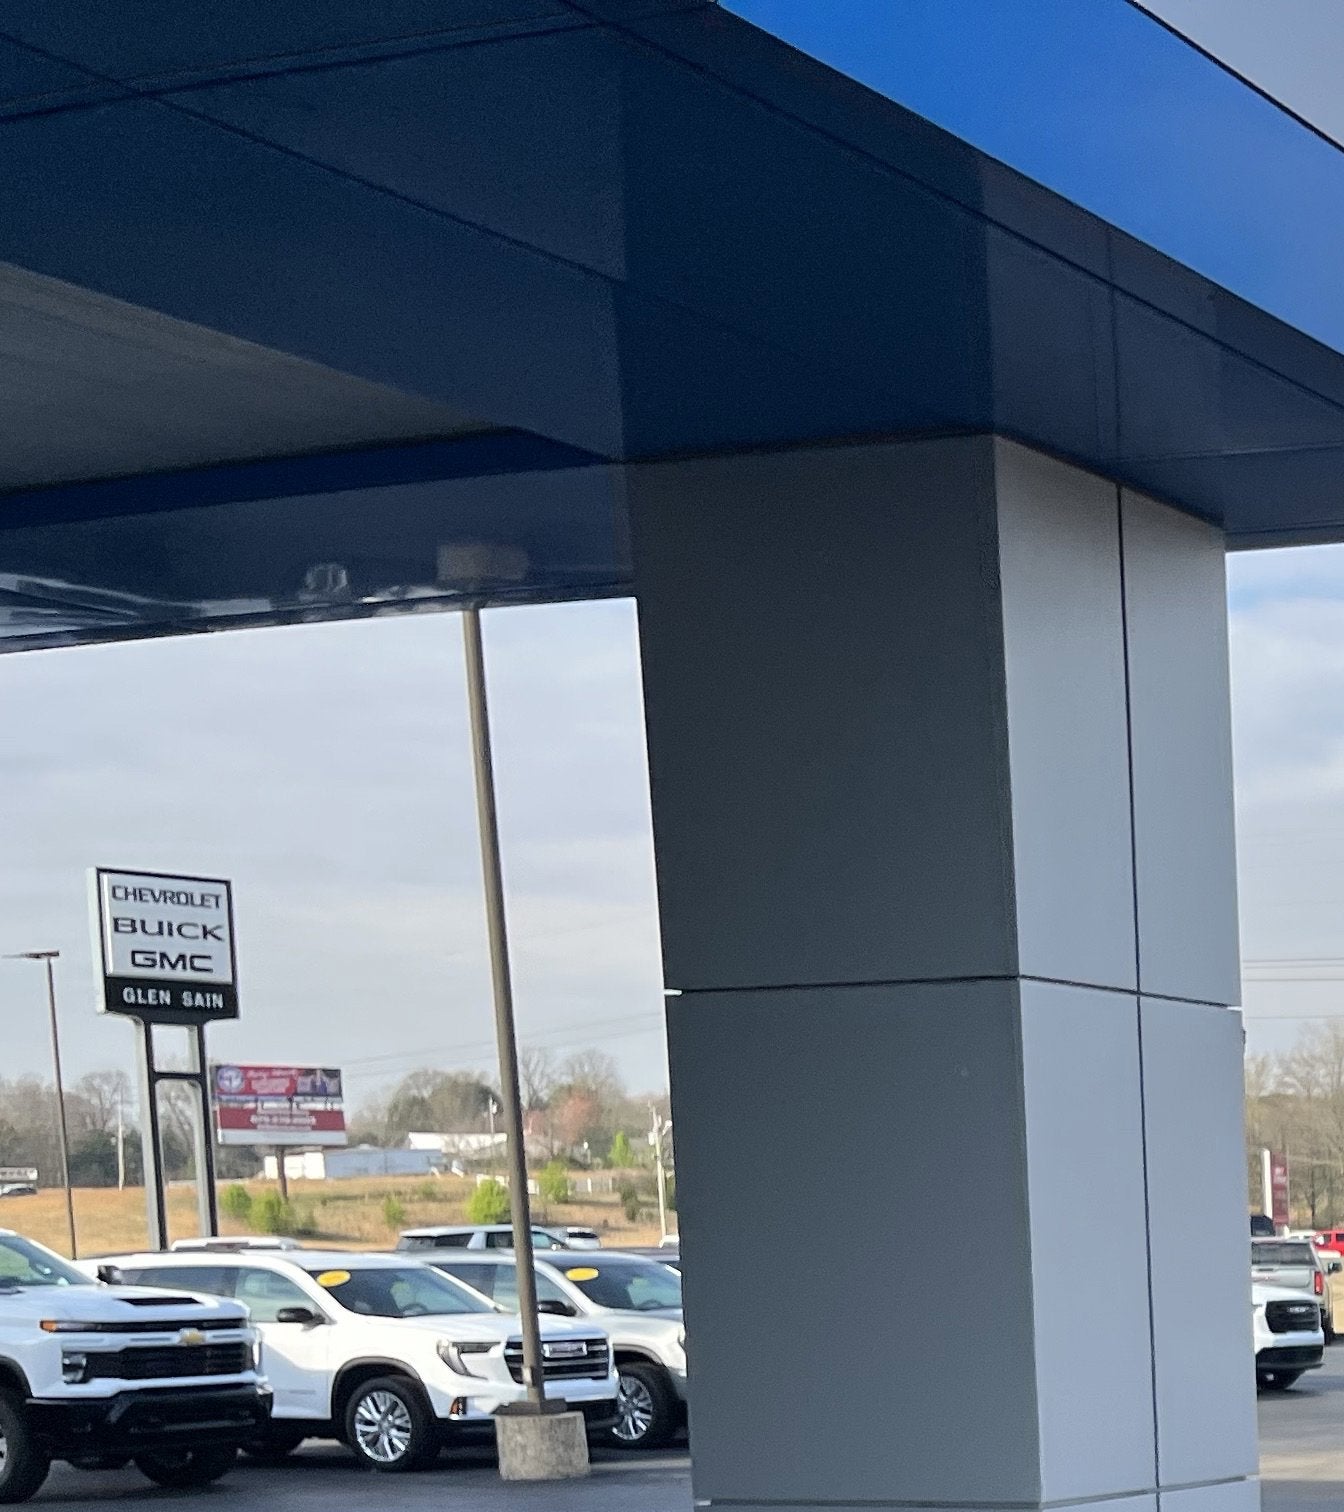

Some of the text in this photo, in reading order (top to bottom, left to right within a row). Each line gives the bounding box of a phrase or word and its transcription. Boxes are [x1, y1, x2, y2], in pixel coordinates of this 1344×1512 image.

[112, 885, 221, 908] CHEVROLET
[113, 917, 223, 941] BUICK
[131, 950, 213, 973] GMC
[122, 987, 224, 1009] GLEN SAIN
